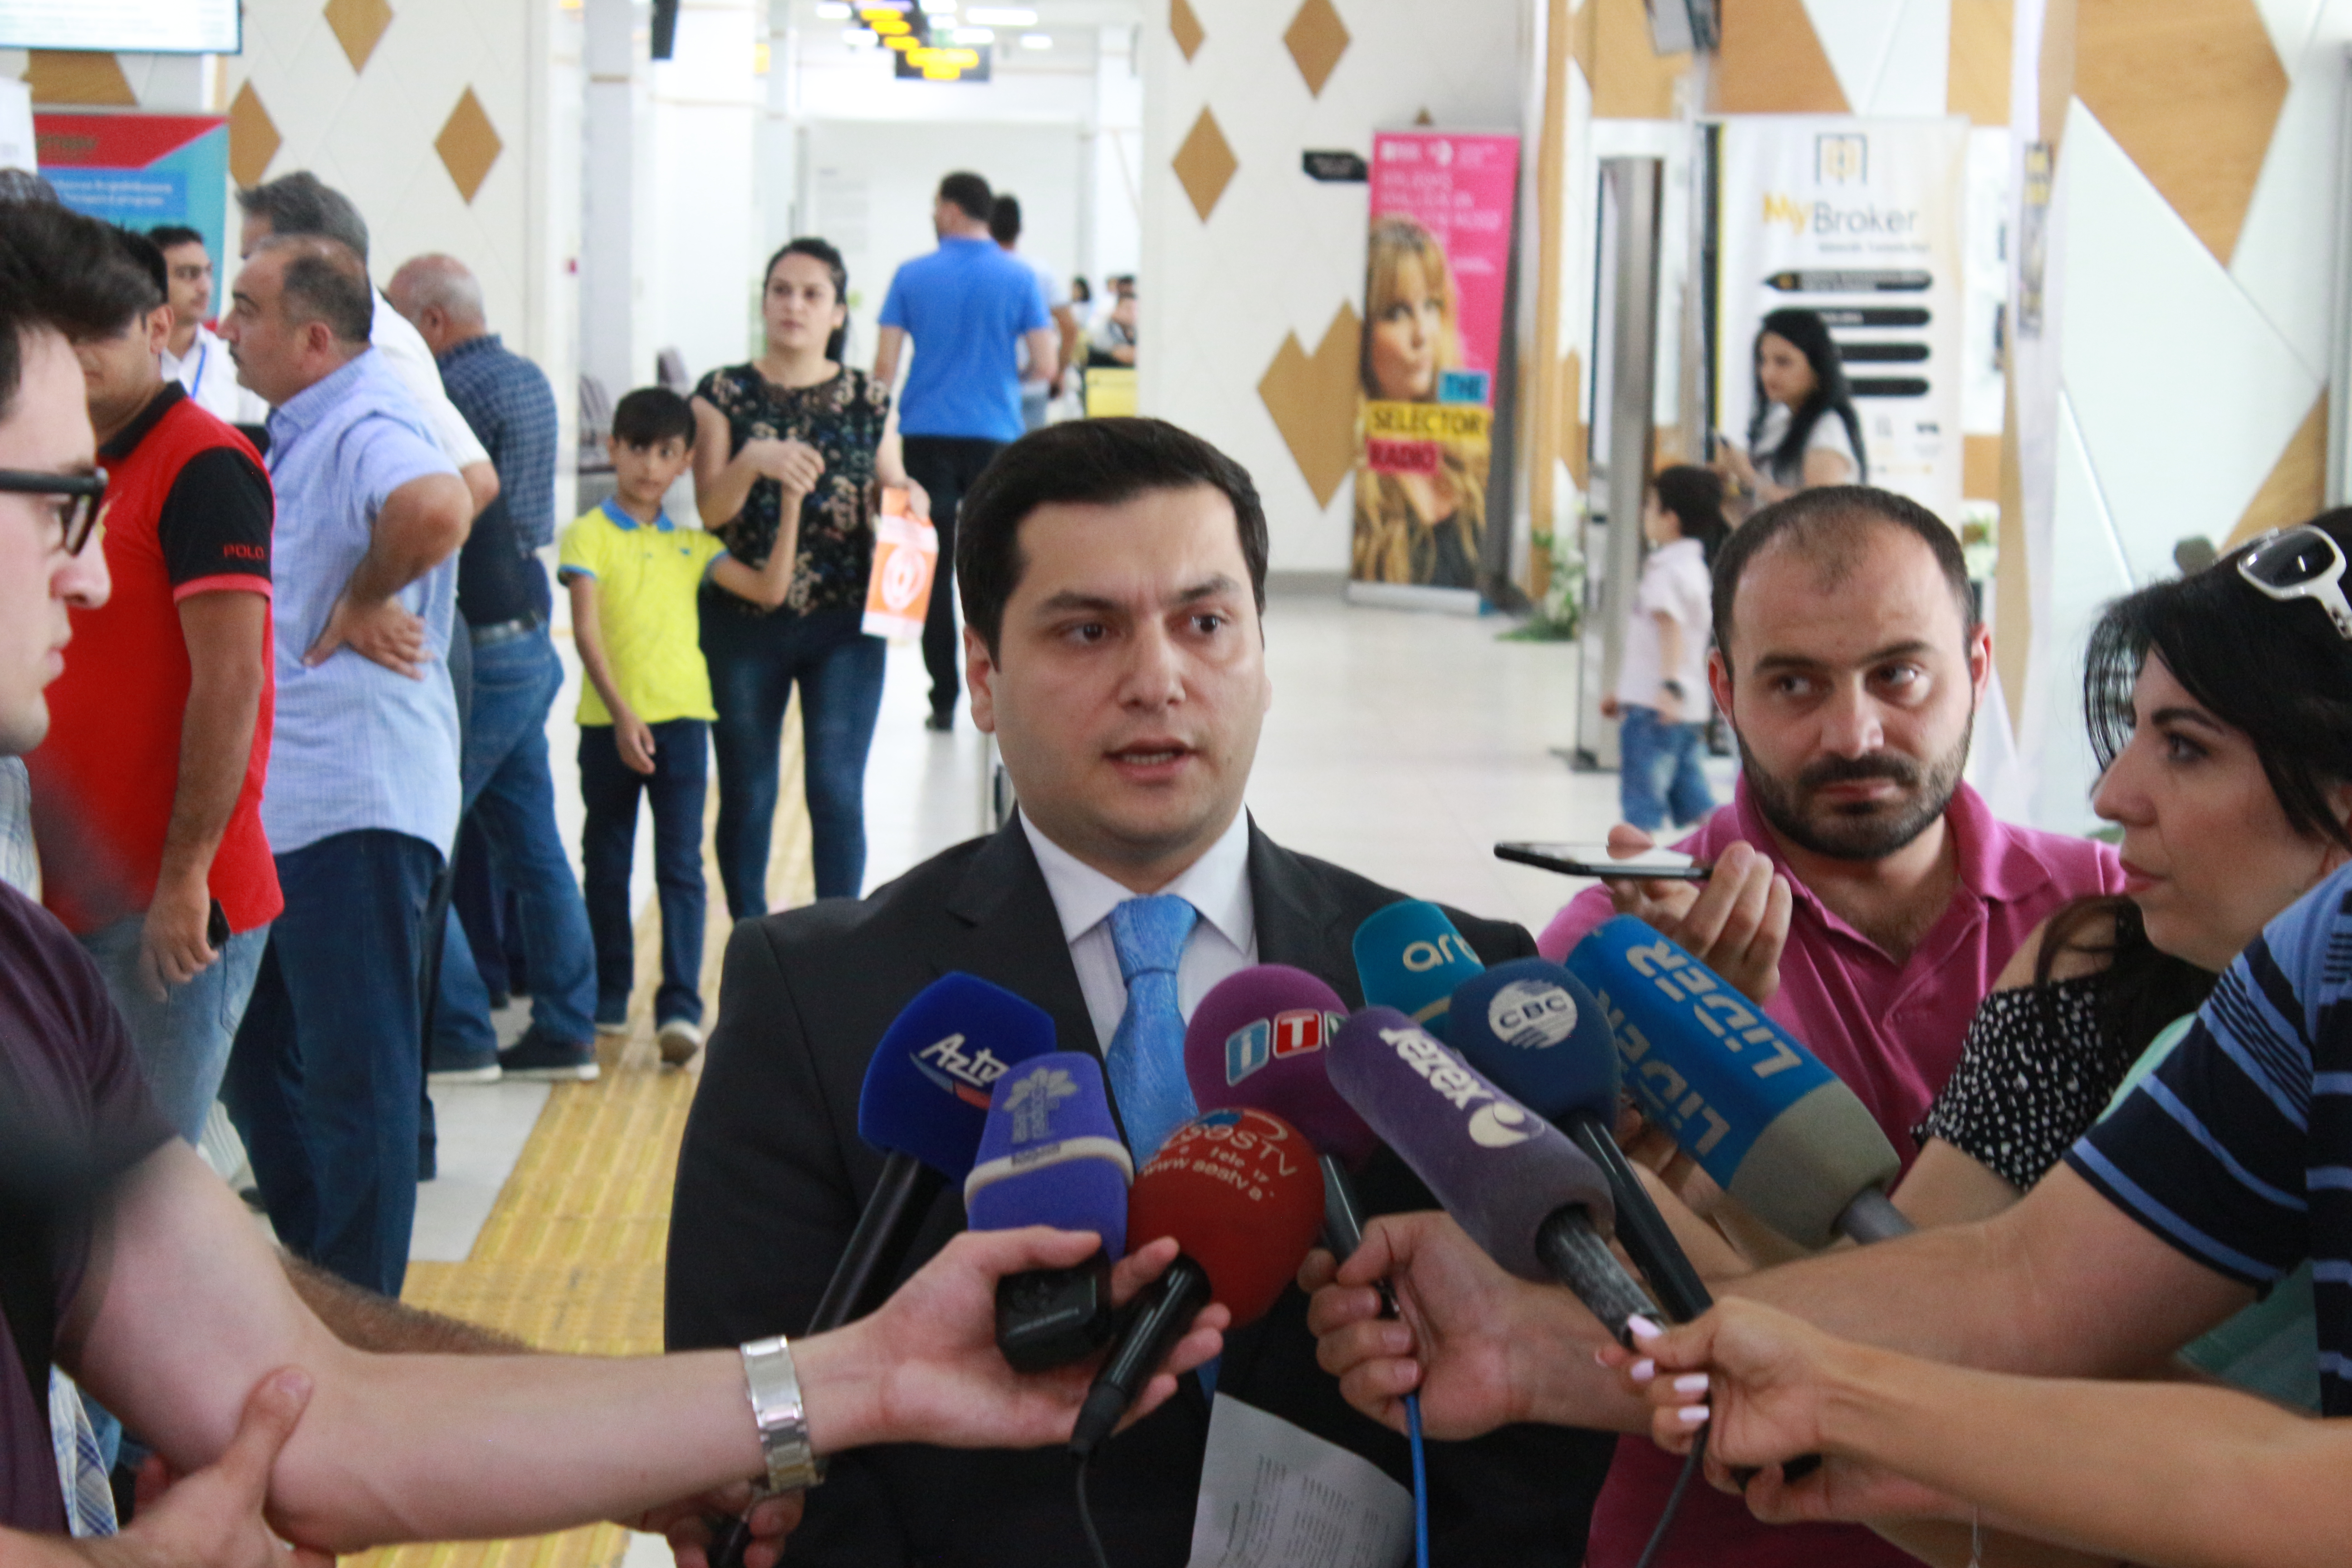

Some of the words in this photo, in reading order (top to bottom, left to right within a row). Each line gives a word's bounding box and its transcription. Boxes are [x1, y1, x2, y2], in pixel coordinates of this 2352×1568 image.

[1445, 373, 1481, 400] THE
[1373, 410, 1482, 434] SELECTOR
[223, 544, 264, 559] POLO
[1499, 995, 1568, 1029] CBC
